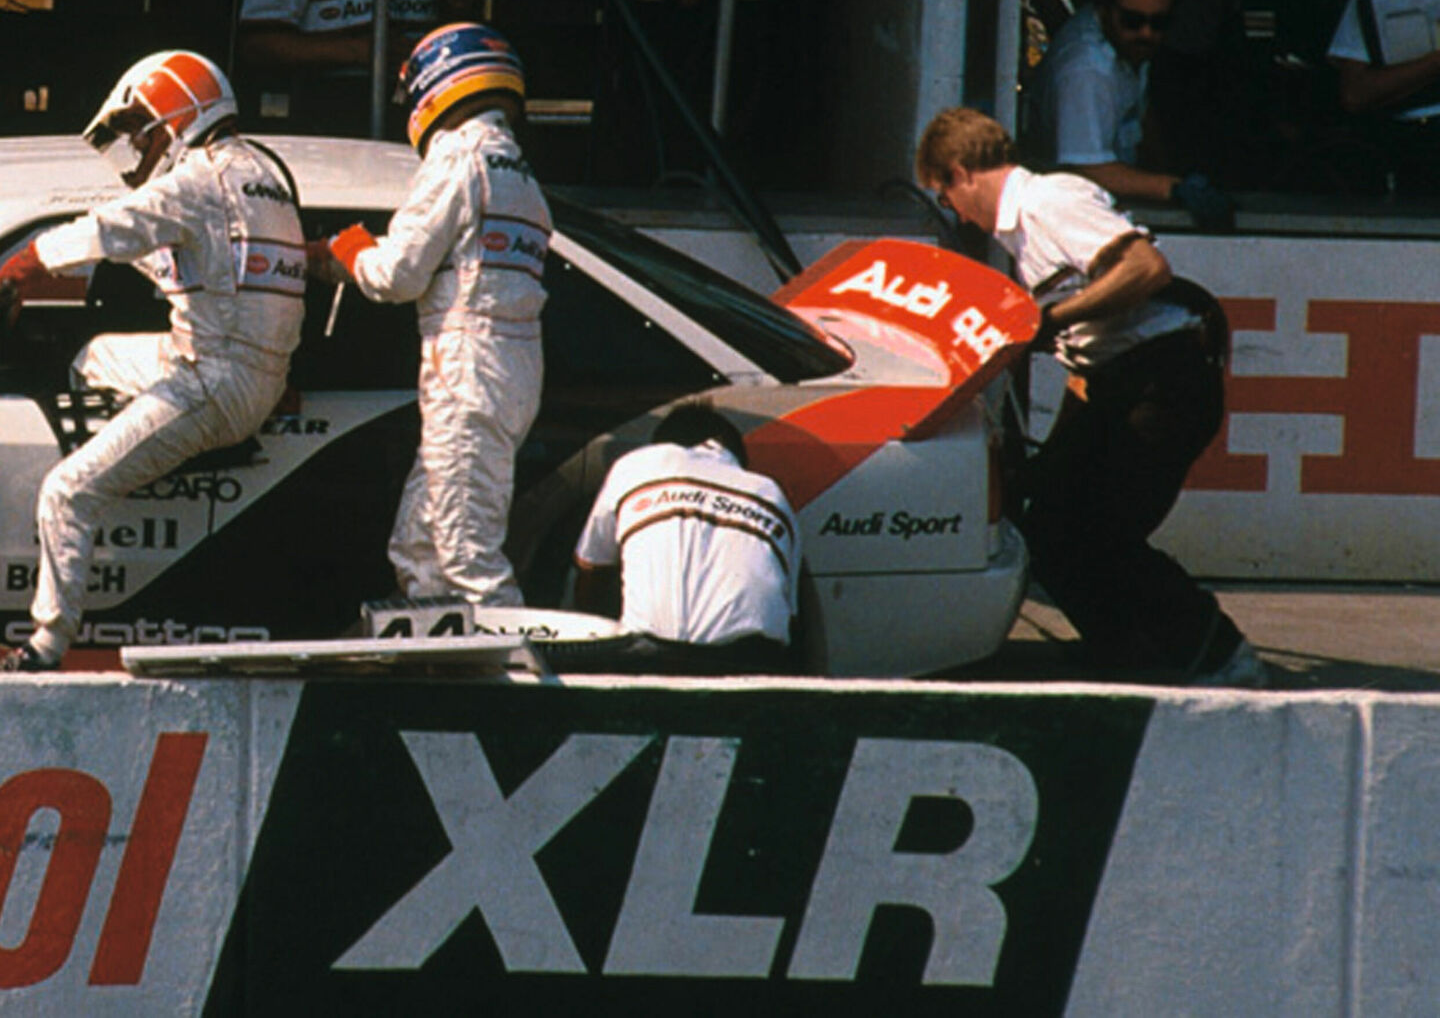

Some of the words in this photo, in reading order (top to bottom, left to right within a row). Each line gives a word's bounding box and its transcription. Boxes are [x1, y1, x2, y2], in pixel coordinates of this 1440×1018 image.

[828, 260, 953, 319] Audi
[127, 474, 242, 503] CARO
[652, 490, 707, 508] Audi
[710, 495, 777, 532] Sport
[820, 512, 884, 537] Audi
[888, 511, 964, 540] Sport
[329, 729, 1040, 988] XLR
